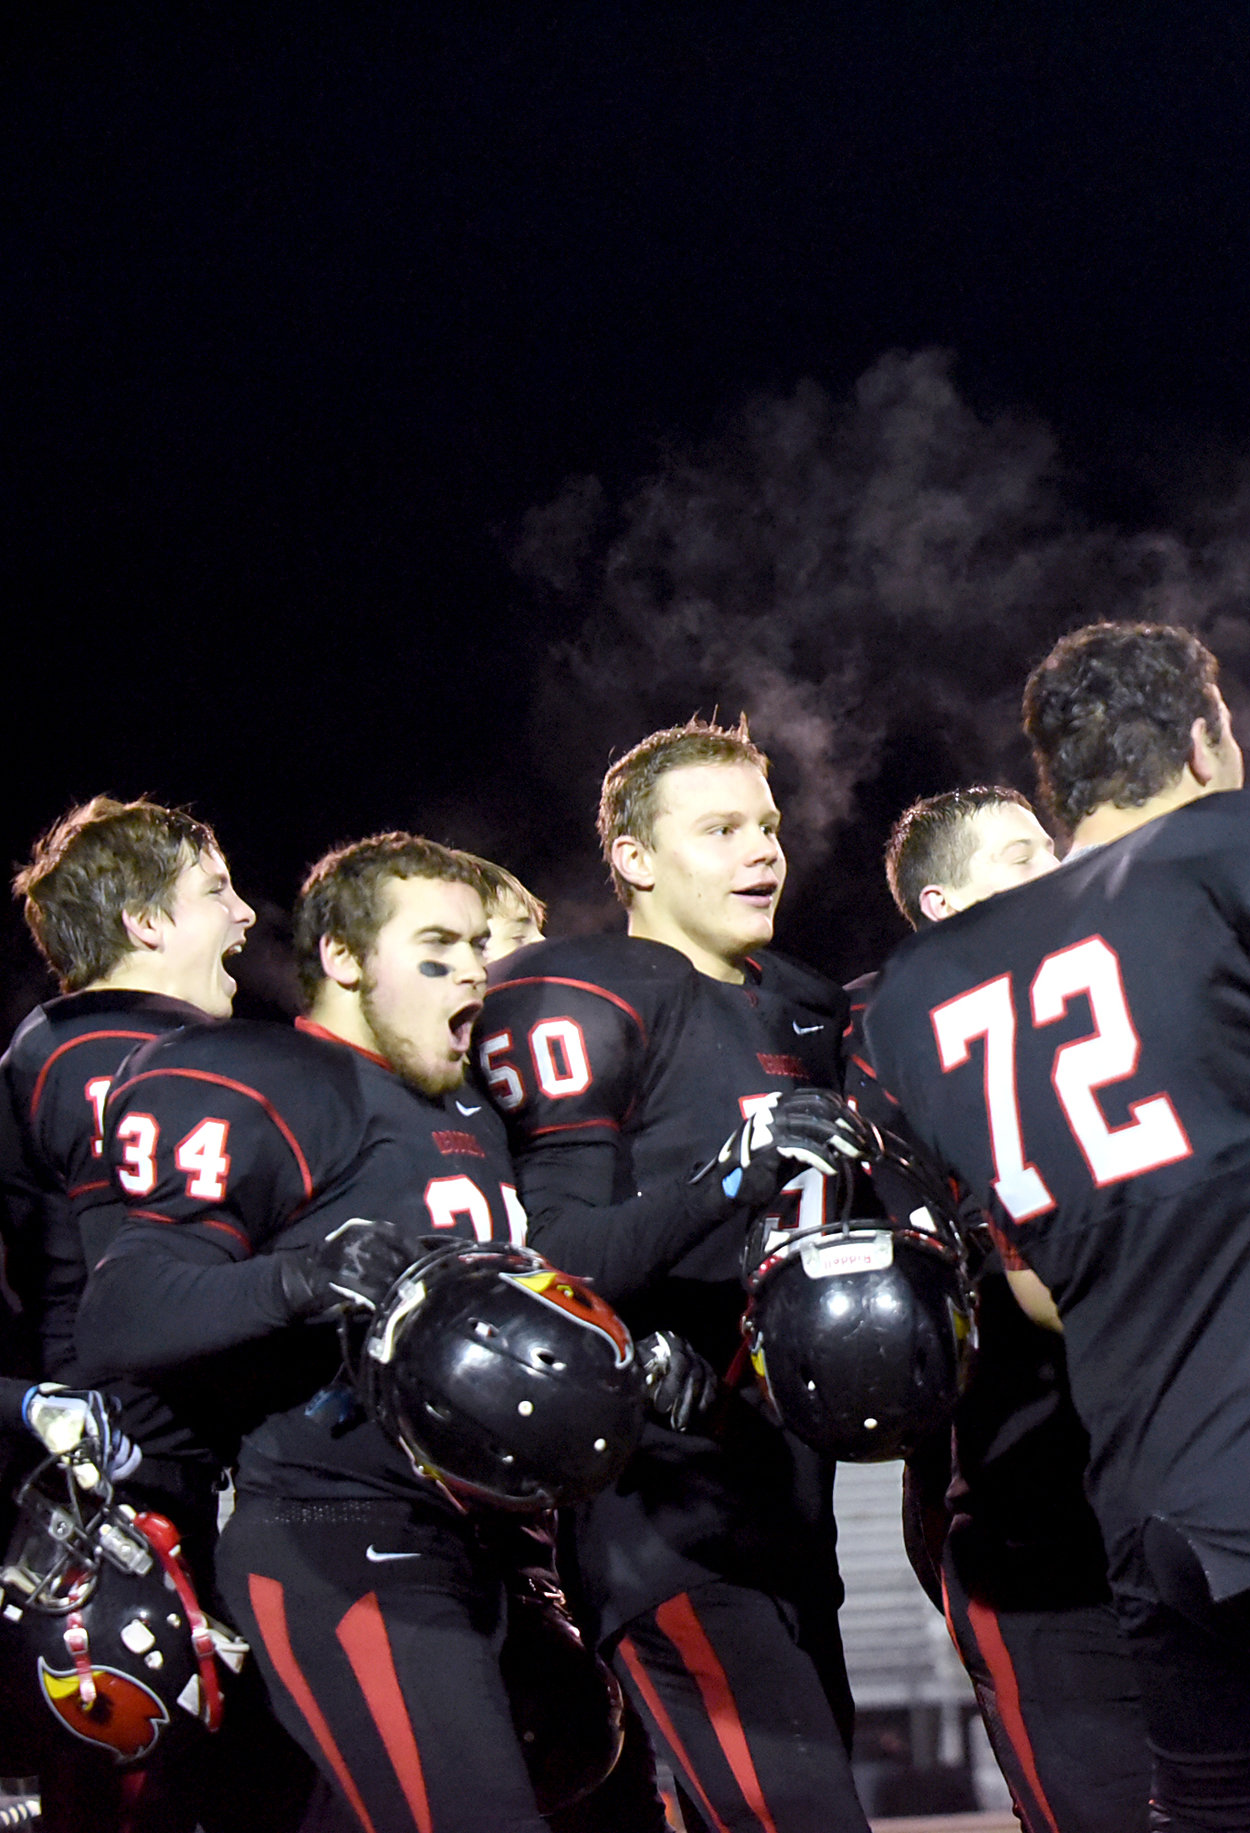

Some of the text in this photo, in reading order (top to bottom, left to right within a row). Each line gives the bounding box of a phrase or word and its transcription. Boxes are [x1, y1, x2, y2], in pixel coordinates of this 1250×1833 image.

[478, 1015, 593, 1114] 50
[929, 933, 1194, 1224] 72
[115, 1111, 232, 1203] 34
[823, 1255, 872, 1269] Riddell
